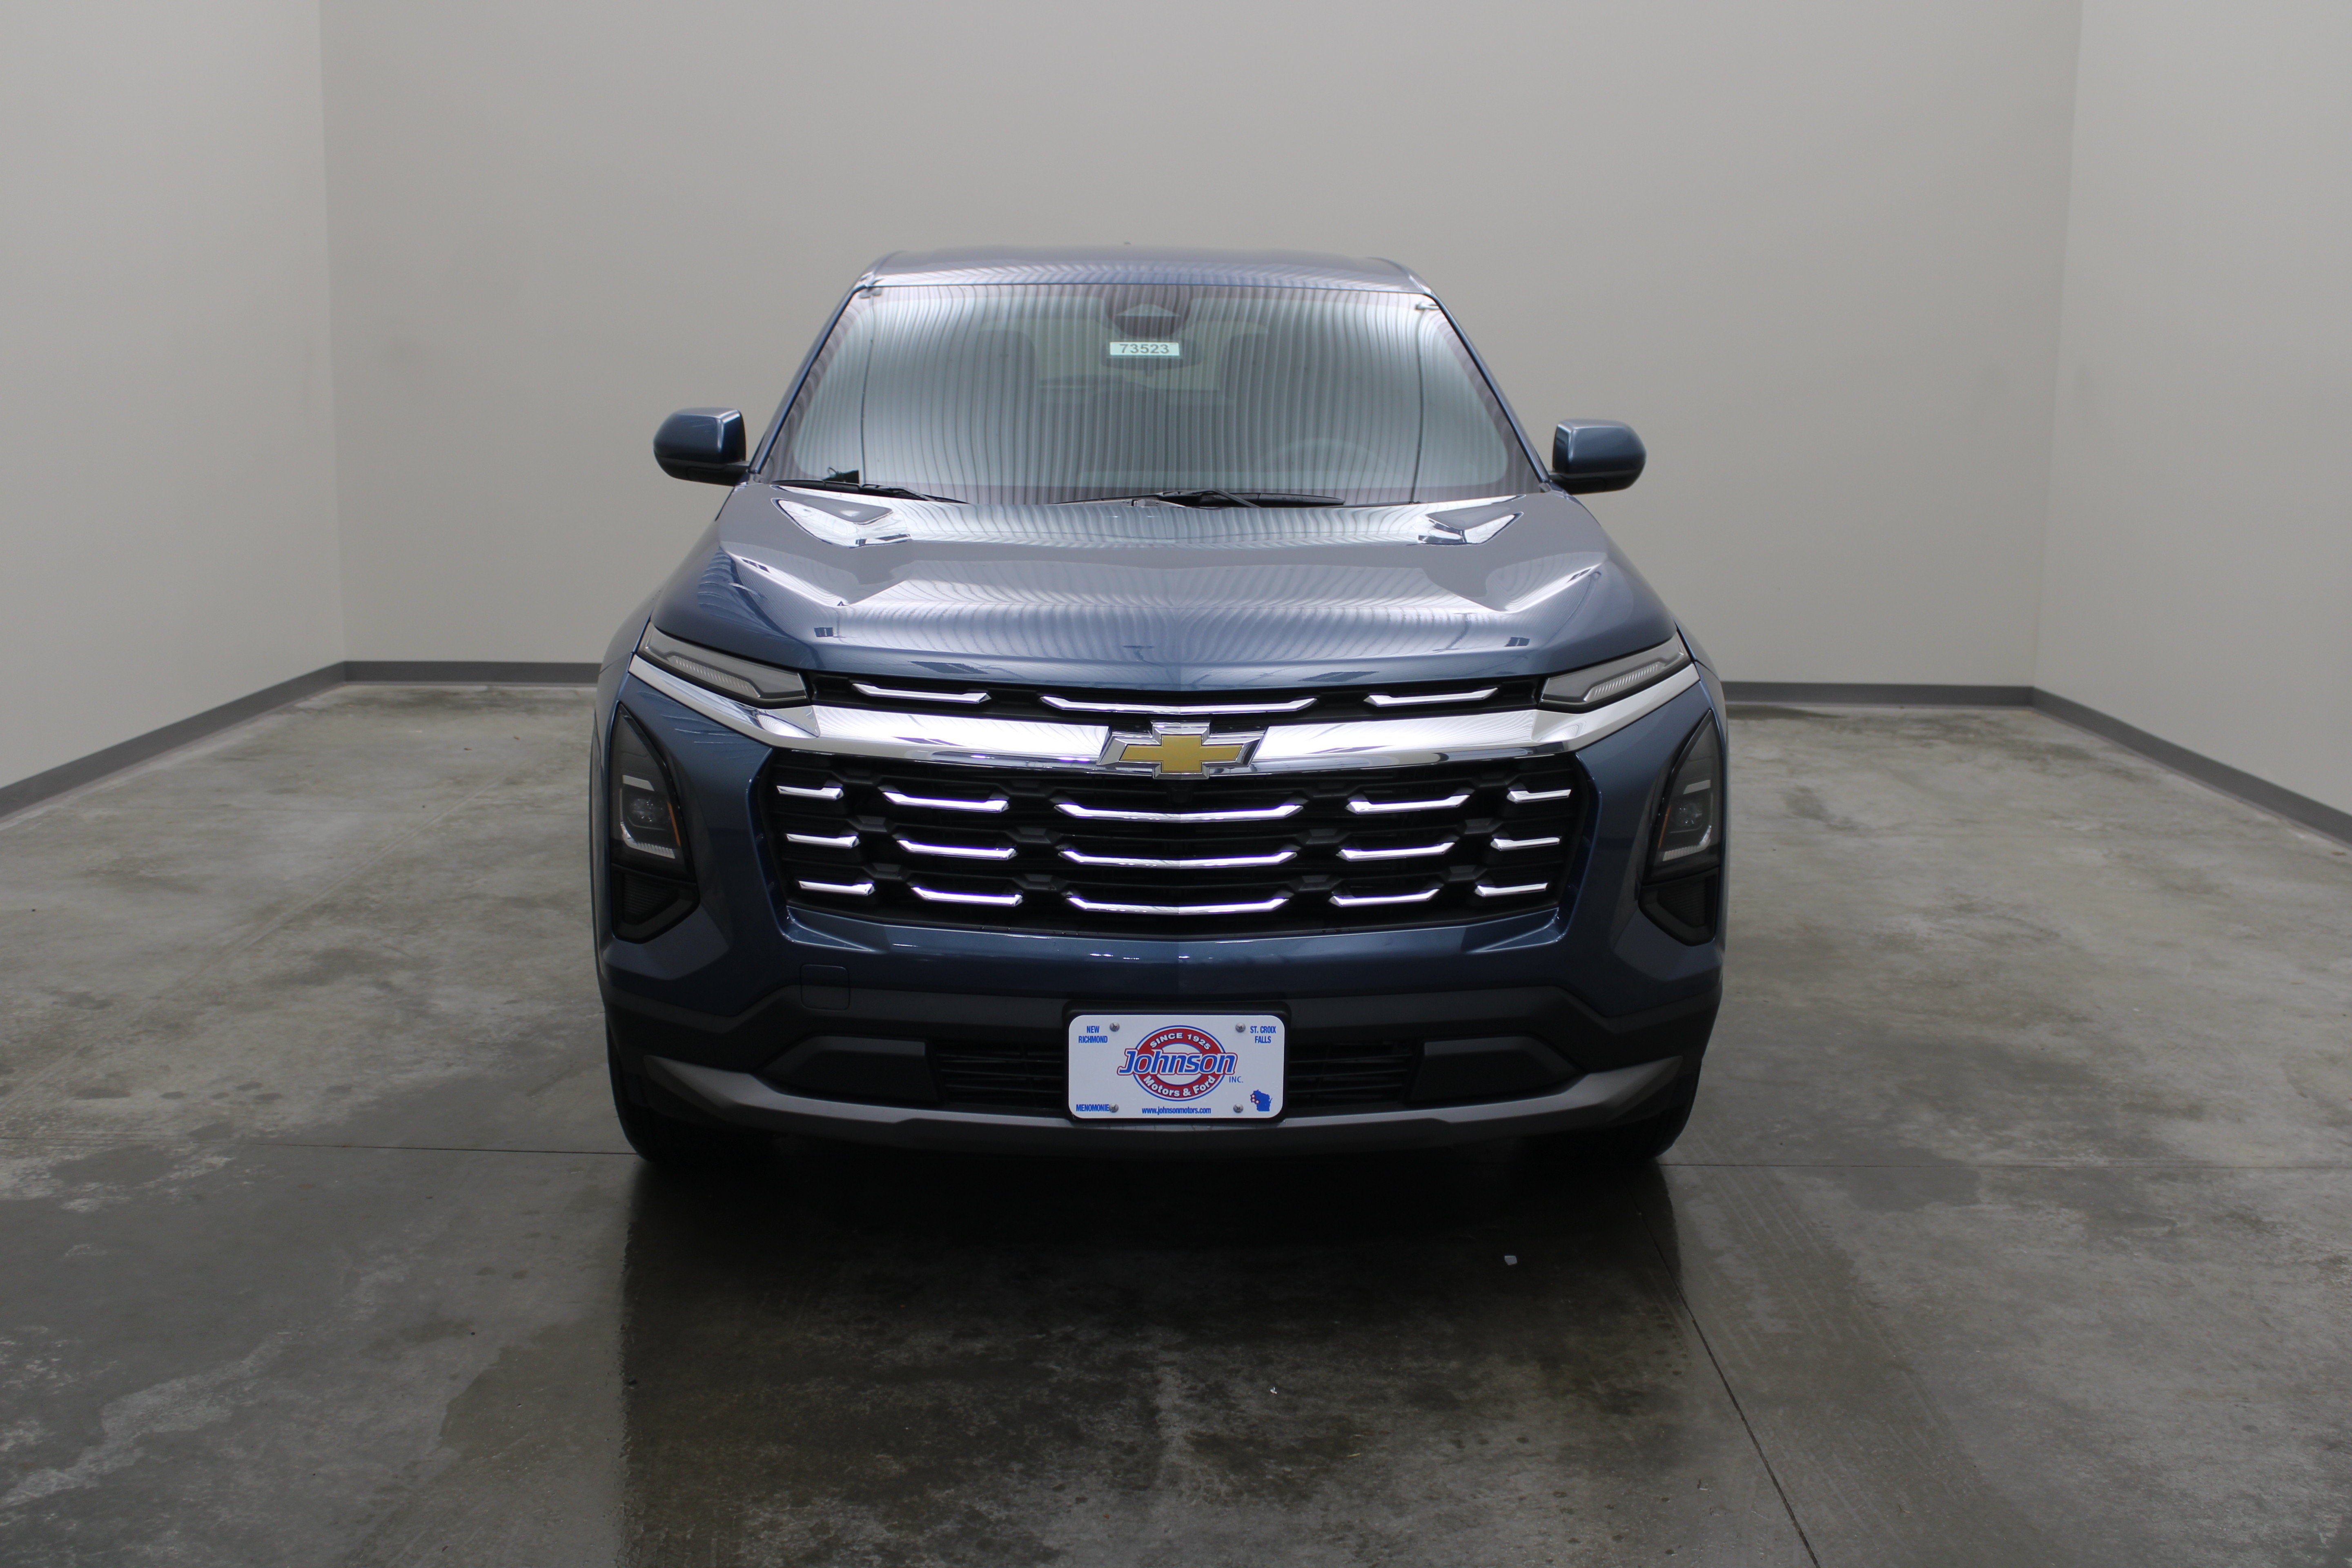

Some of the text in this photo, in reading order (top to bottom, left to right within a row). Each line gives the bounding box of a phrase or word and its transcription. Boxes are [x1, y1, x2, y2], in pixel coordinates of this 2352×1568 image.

[1119, 344, 1169, 354] 73523
[1078, 1036, 1108, 1044] RICHMOND
[1150, 1032, 1211, 1050] SINCE 1925
[1119, 1050, 1237, 1074] Johnson
[1143, 1075, 1216, 1097] Motors & Ford
[1142, 1106, 1212, 1115] www.johnsonmotors.com
